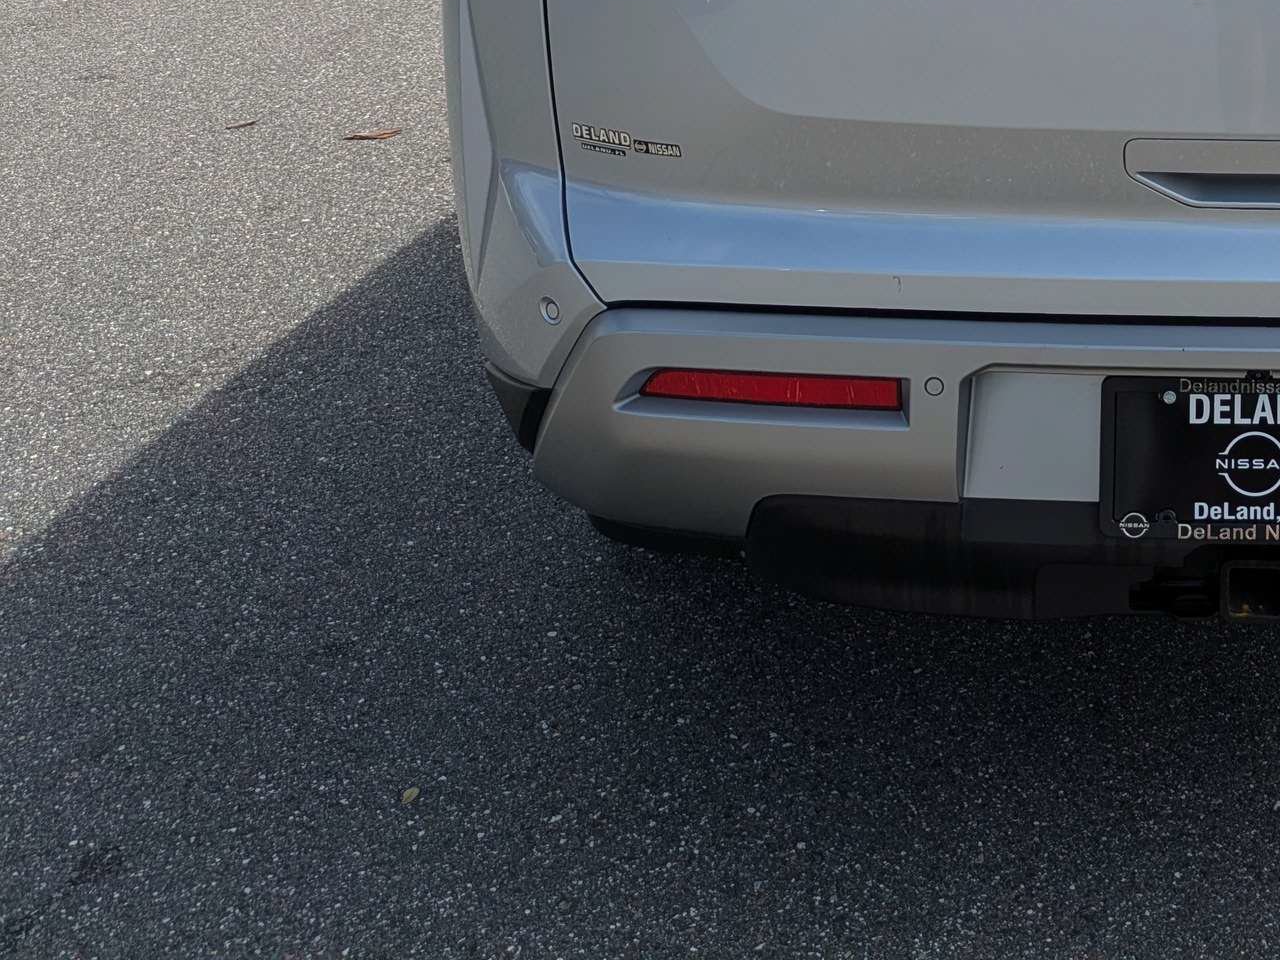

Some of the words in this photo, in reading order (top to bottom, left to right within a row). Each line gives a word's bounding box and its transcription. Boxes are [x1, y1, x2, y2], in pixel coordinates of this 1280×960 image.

[572, 123, 631, 146] DELAND
[648, 143, 680, 156] NISSAN
[1177, 523, 1257, 540] DeLand
